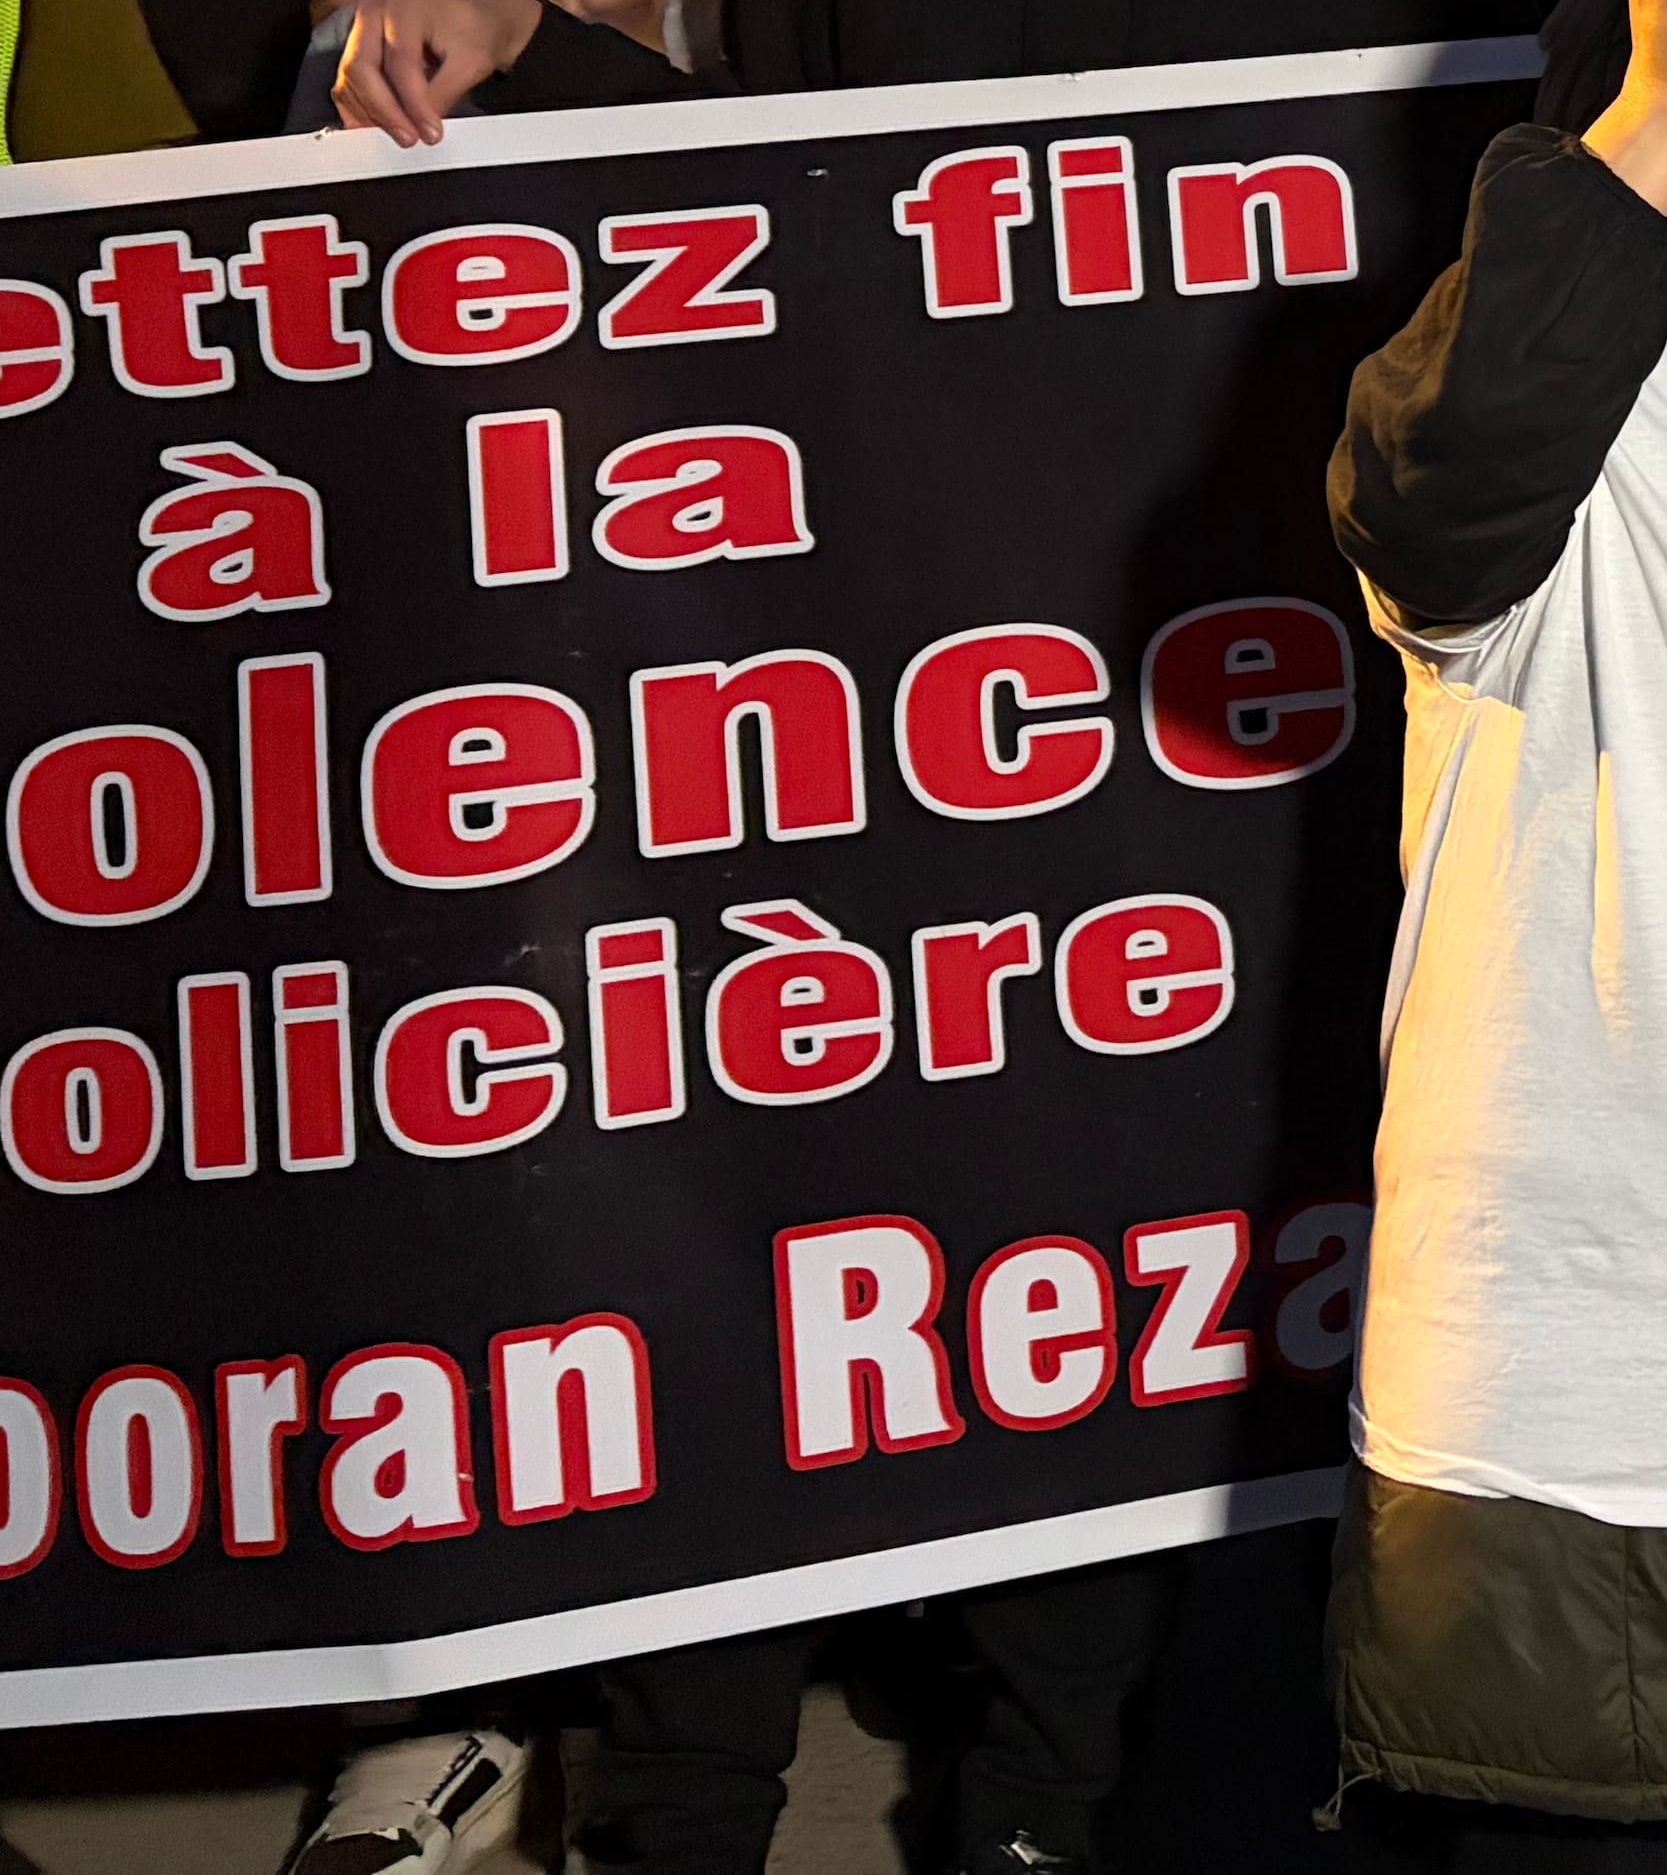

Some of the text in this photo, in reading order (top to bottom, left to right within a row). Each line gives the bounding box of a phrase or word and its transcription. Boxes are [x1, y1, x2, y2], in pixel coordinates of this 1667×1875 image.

[890, 134, 1361, 321] fin
[135, 406, 817, 624] à la
[4, 596, 1357, 928] olence
[0, 898, 1237, 1196] olicière
[771, 1191, 1373, 1473] Reza
